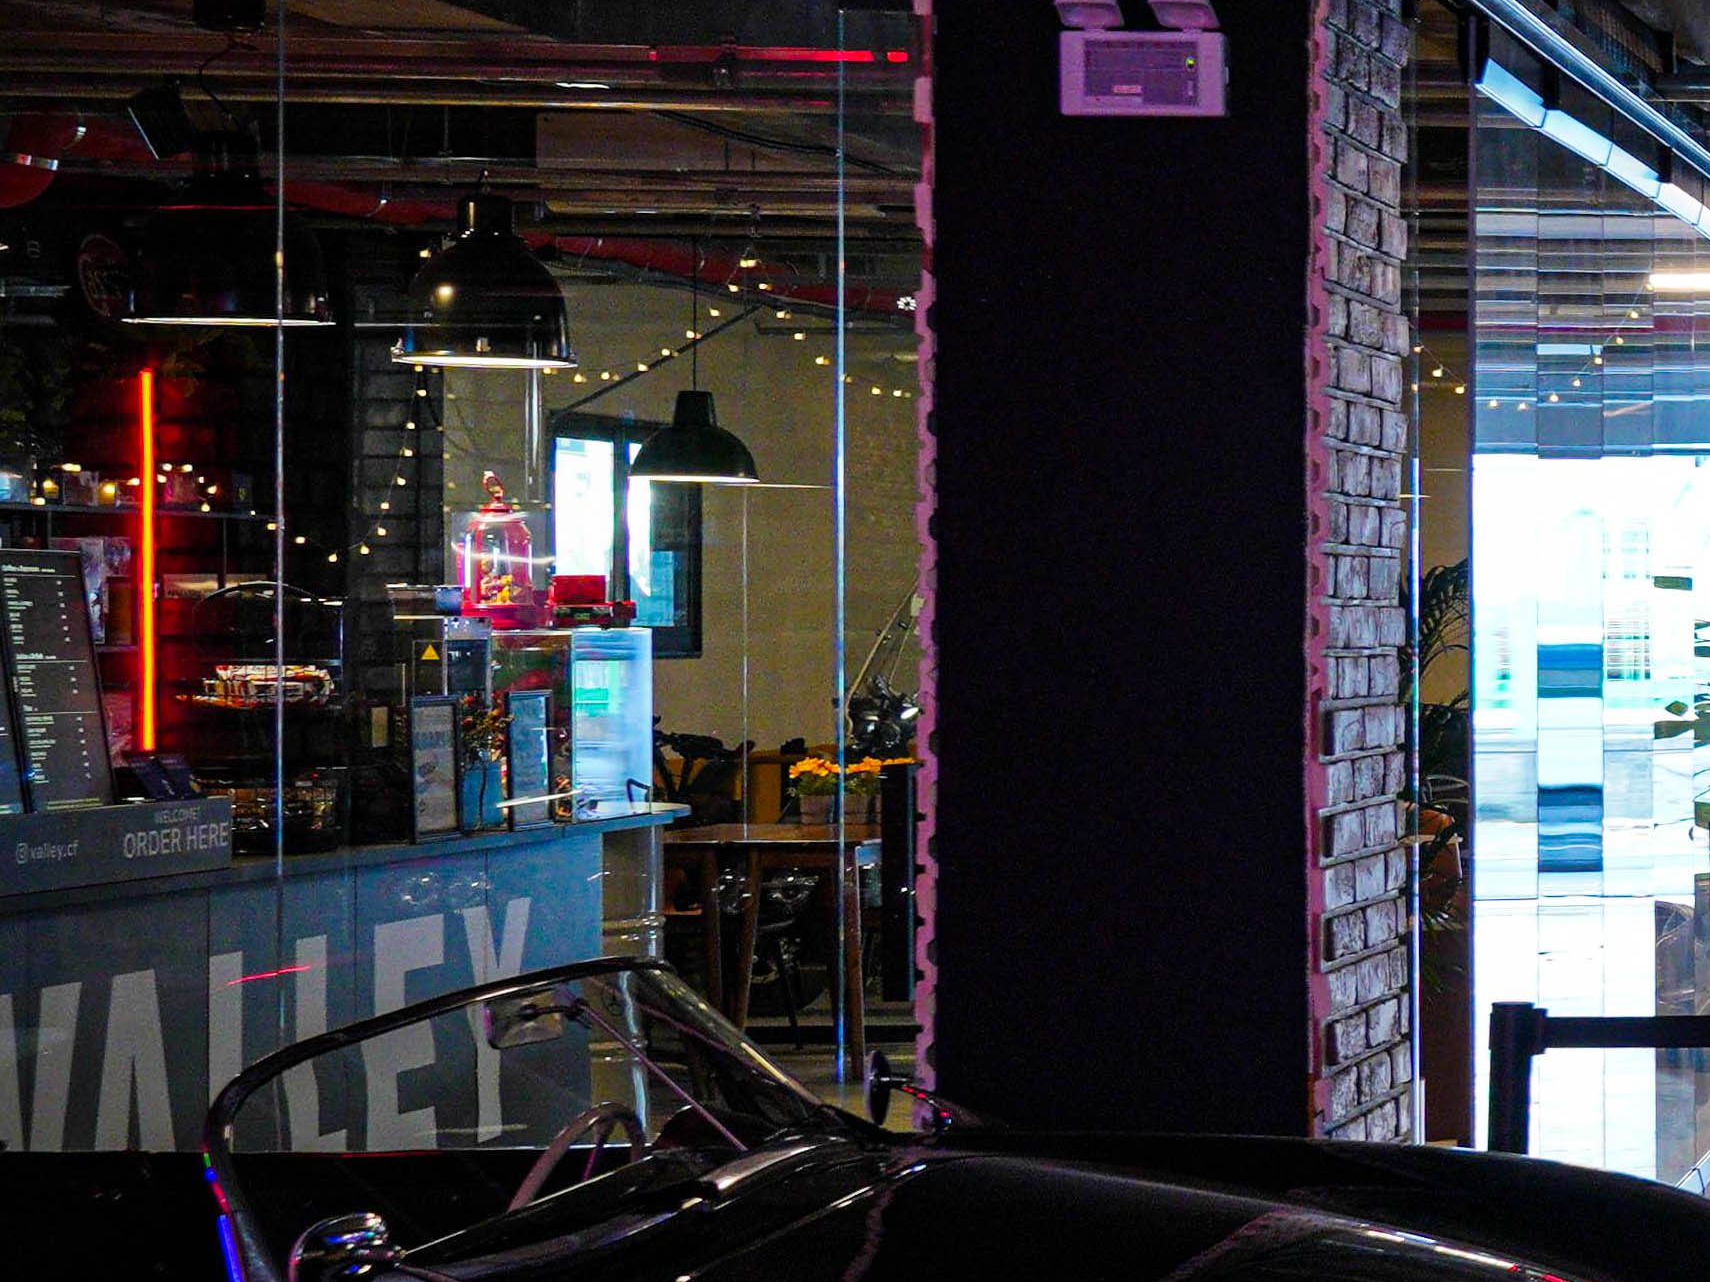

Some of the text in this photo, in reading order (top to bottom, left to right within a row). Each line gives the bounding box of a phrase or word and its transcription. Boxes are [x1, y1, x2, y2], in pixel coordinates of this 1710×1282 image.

[123, 821, 229, 859] ORDER HERE
[0, 897, 532, 1153] VALLEY
